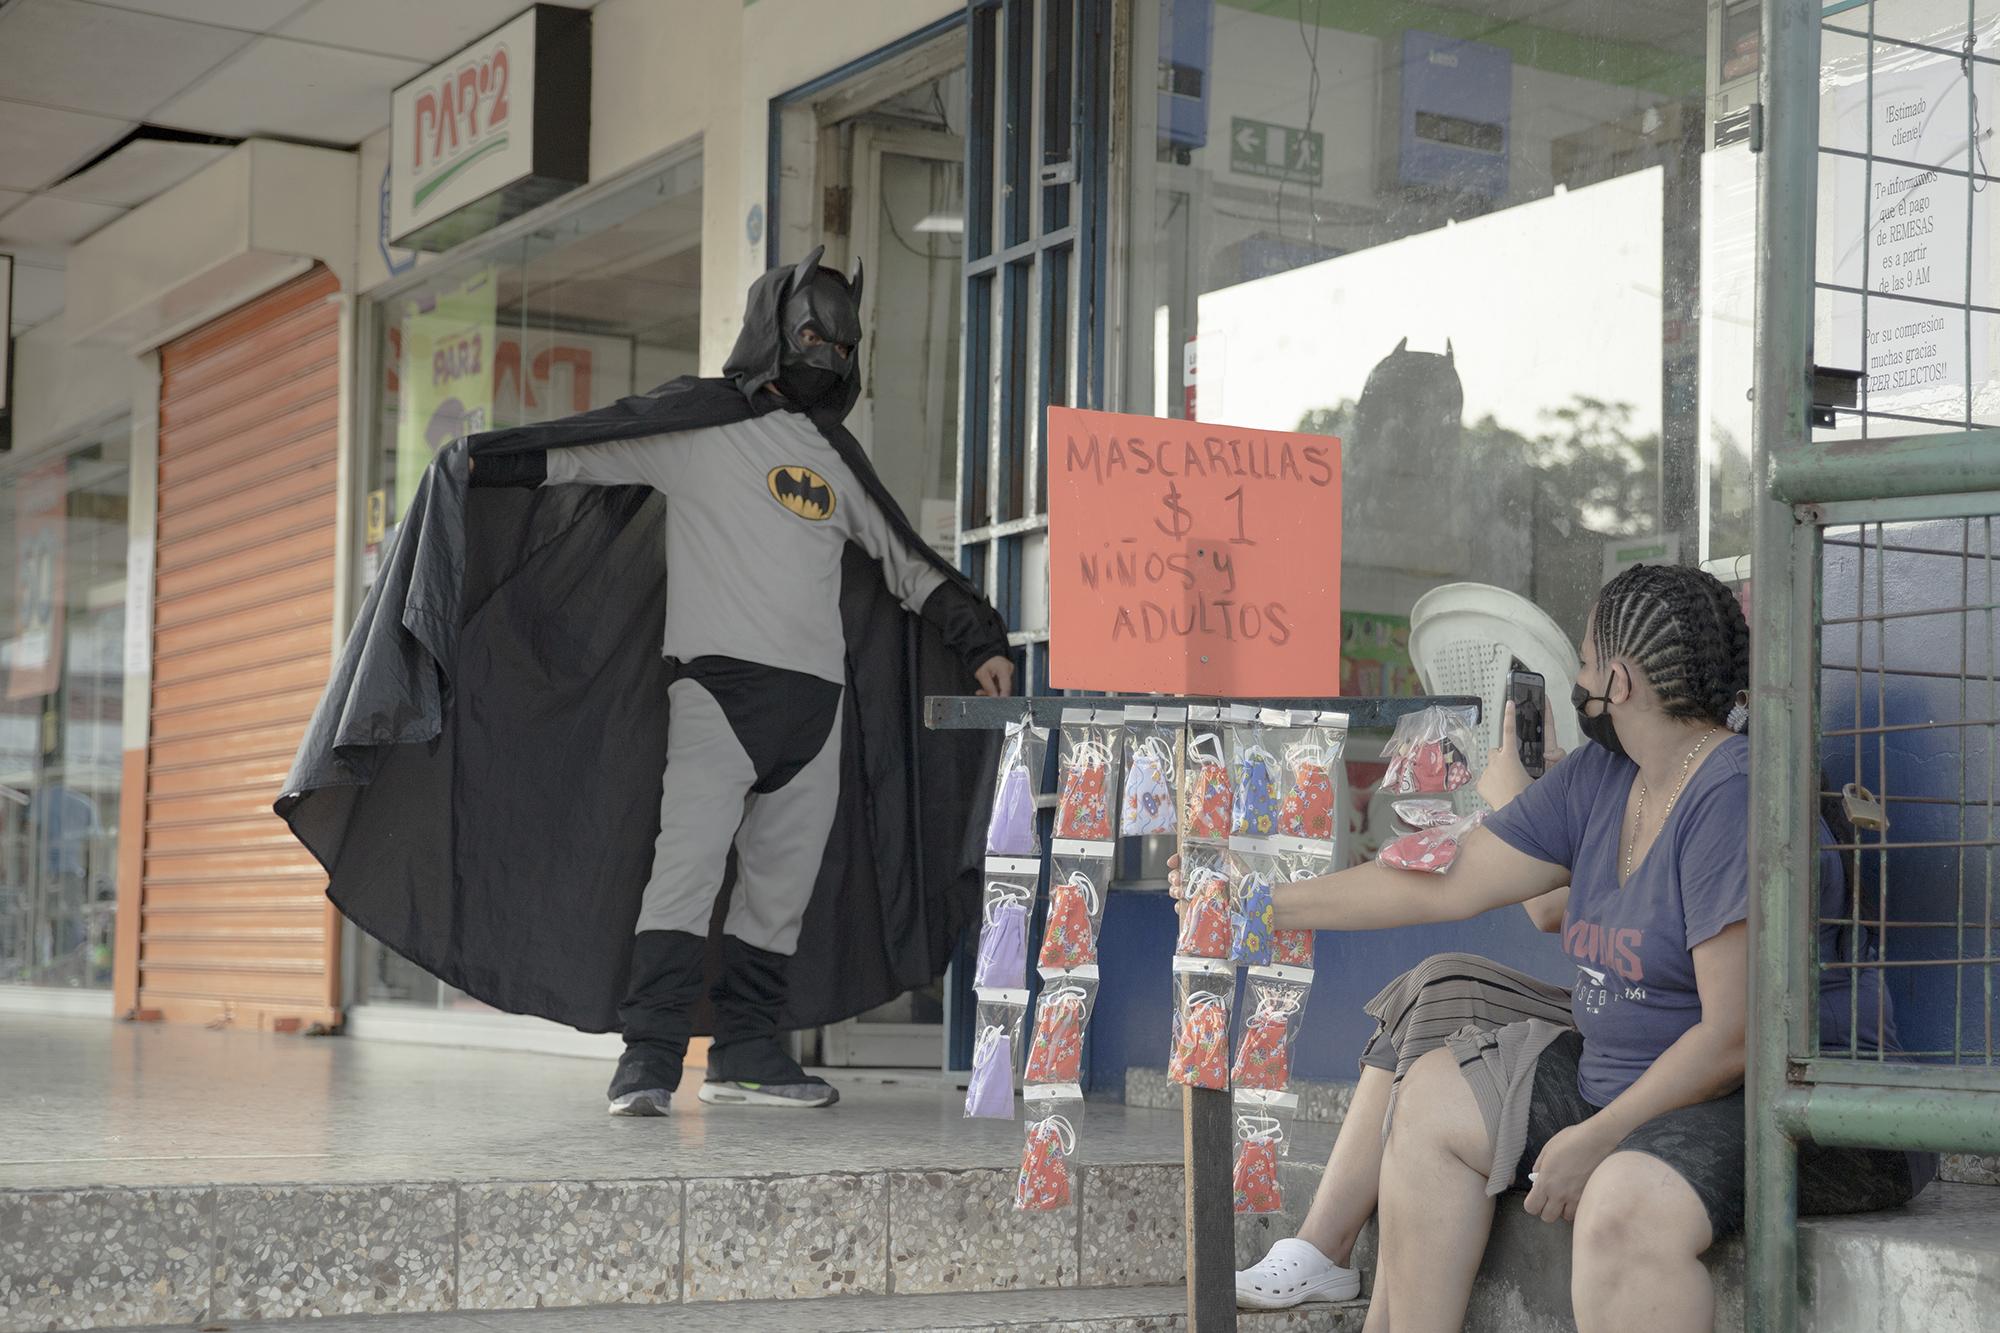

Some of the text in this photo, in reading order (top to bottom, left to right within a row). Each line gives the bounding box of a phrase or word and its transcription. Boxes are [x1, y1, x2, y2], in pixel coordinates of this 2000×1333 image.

[1887, 171, 1938, 196] informamos
[1879, 196, 1930, 223] que el pago
[1876, 216, 1934, 247] de REMESAS
[1882, 242, 1928, 269] es a partir
[1878, 265, 1931, 293] de las 9 AM
[1882, 328, 1892, 343] su
[1871, 341, 1937, 369] muchas gracias
[1860, 361, 1947, 394] UPER SELECTOS!!
[1065, 433, 1333, 487] MASCARILLAS
[1153, 480, 1257, 546] $ 1
[1111, 590, 1291, 647] ADULTOS
